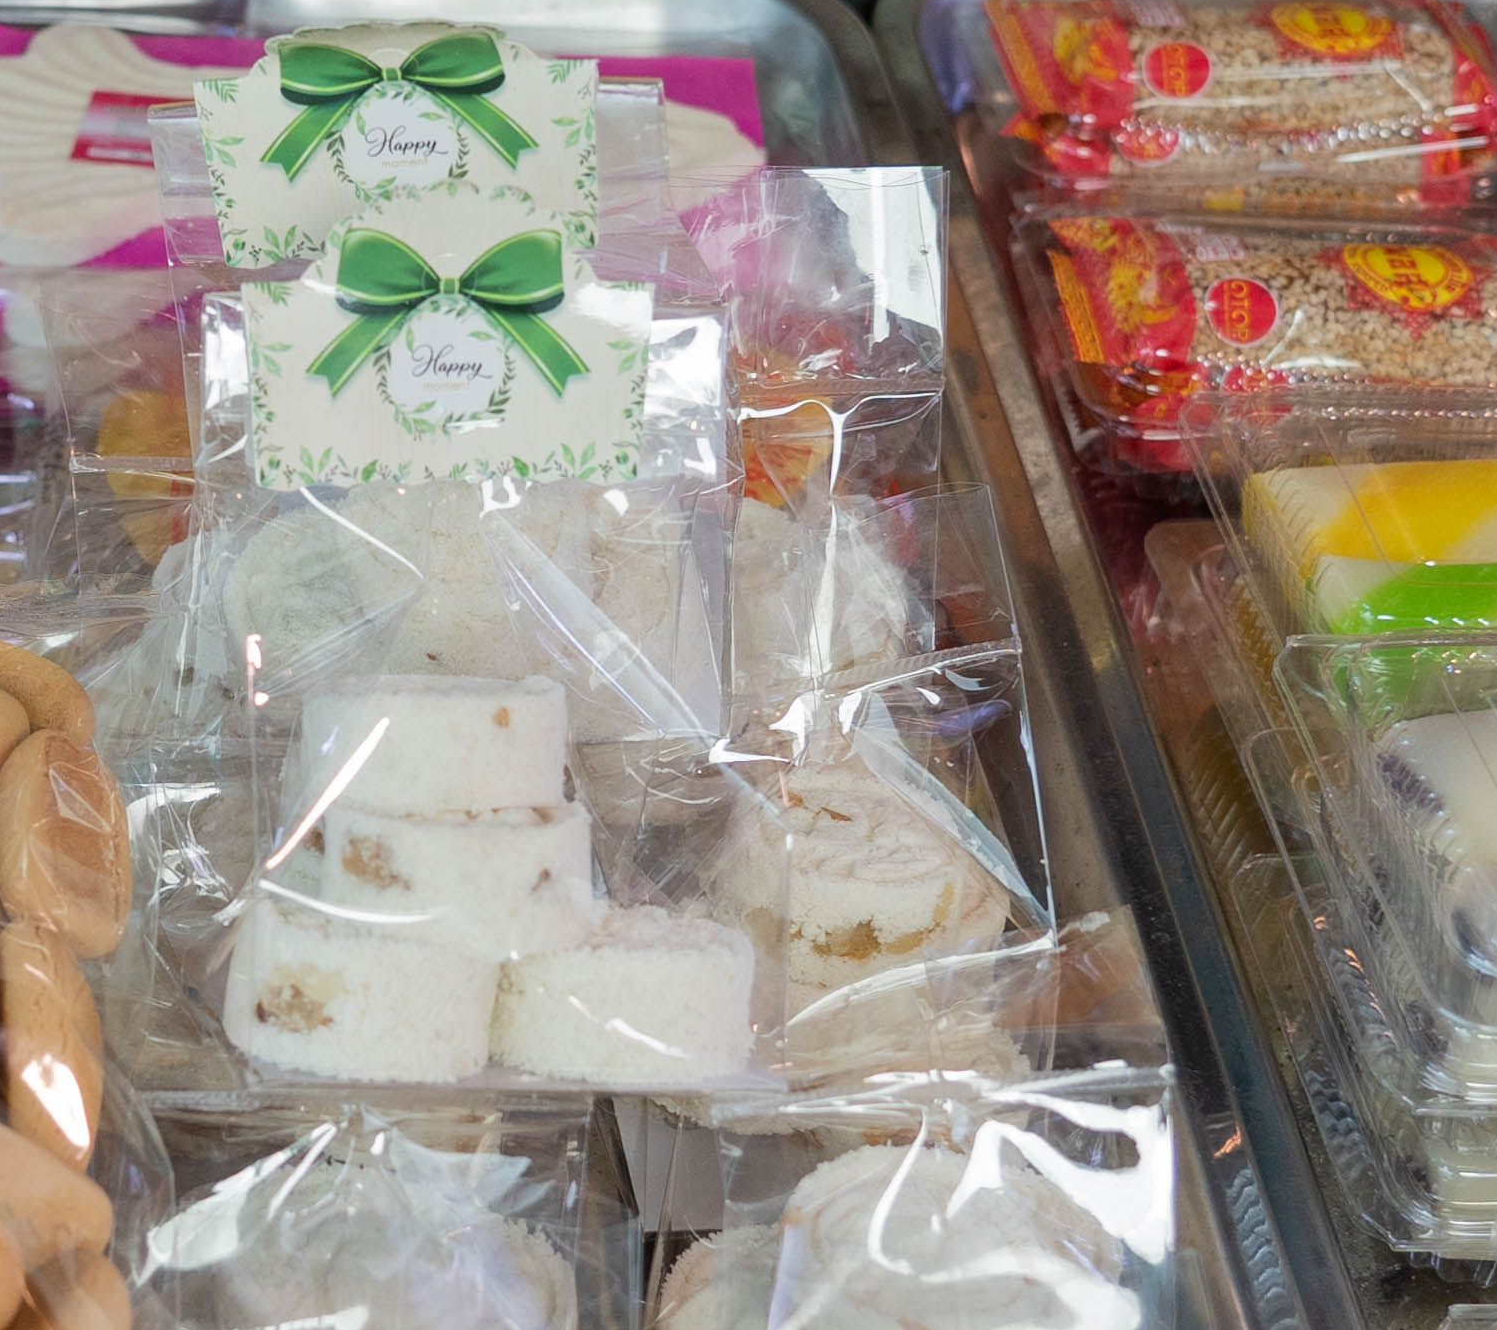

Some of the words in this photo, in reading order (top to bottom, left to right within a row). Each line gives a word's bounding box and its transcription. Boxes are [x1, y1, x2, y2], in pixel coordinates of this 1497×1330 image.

[365, 125, 448, 158] Happy
[382, 156, 428, 170] moment
[412, 343, 493, 379] Happy
